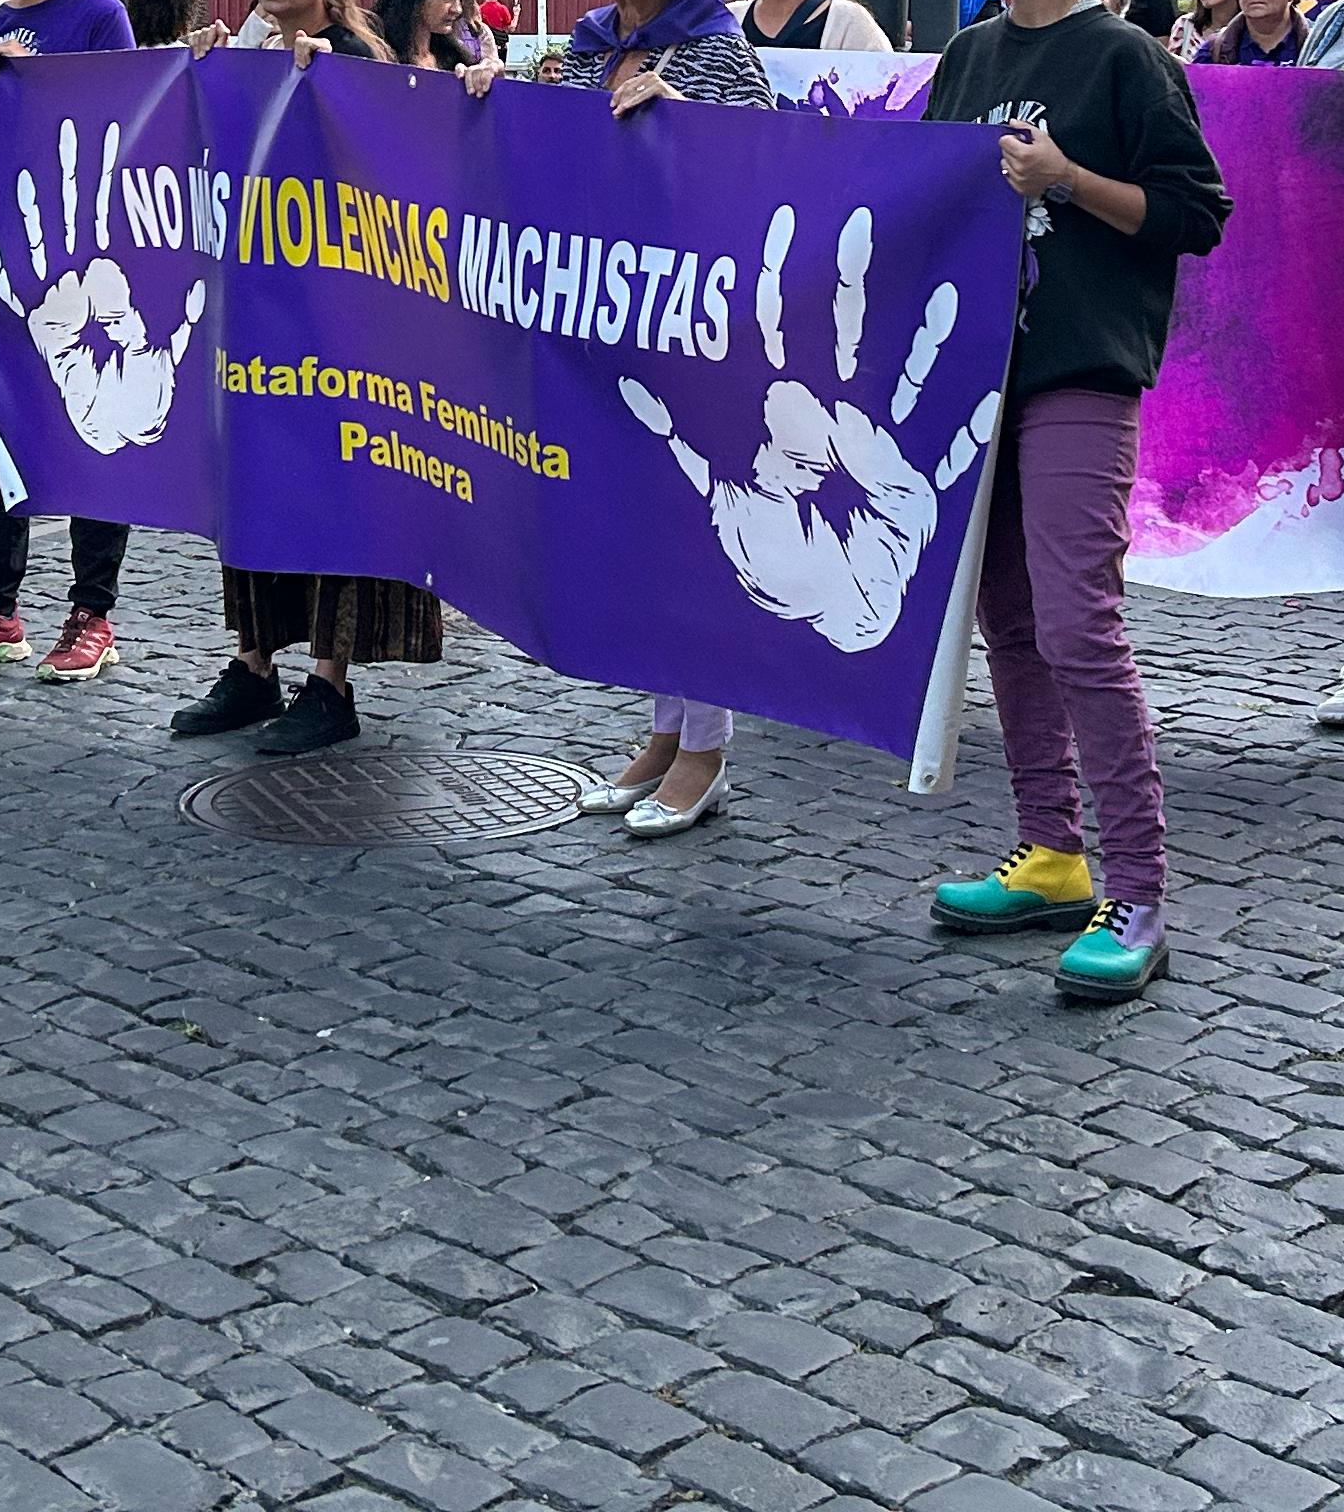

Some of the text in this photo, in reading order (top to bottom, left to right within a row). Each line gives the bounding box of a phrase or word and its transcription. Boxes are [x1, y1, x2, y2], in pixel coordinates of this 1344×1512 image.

[121, 148, 737, 362] NO MÁS VIOLENCIAS MACHISTAS
[215, 347, 570, 480] Plataforma Feminista
[340, 421, 473, 503] Palmera
